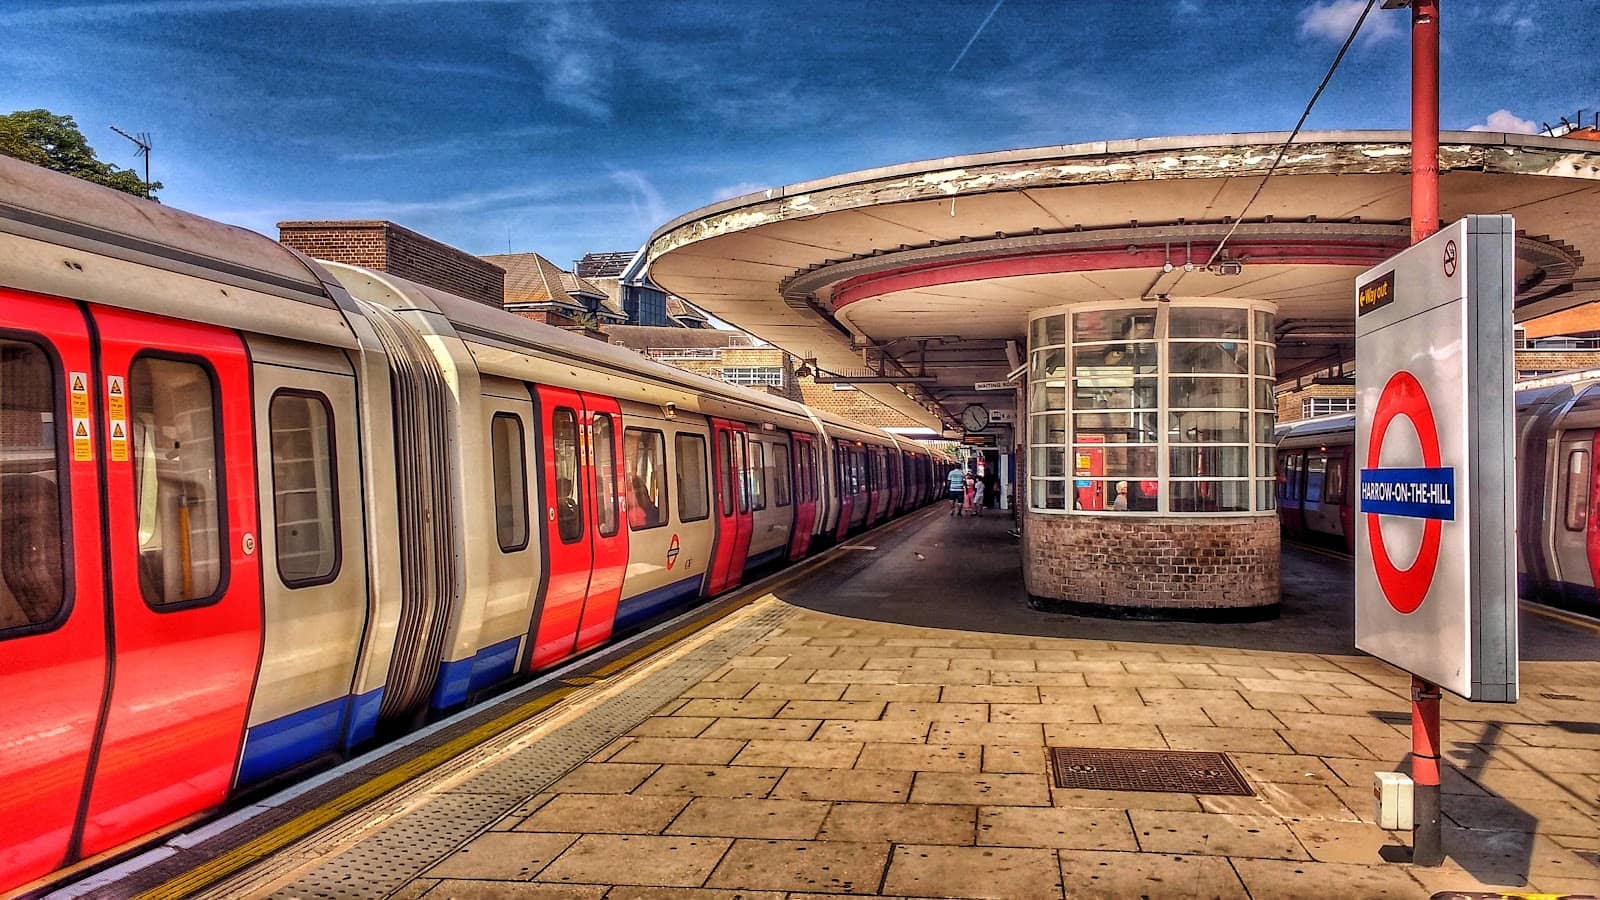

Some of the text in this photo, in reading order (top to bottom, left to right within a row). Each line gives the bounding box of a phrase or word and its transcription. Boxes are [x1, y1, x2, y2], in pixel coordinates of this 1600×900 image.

[1365, 280, 1388, 305] Way out
[1361, 482, 1451, 505] HARROW-ON-THE-HILL
